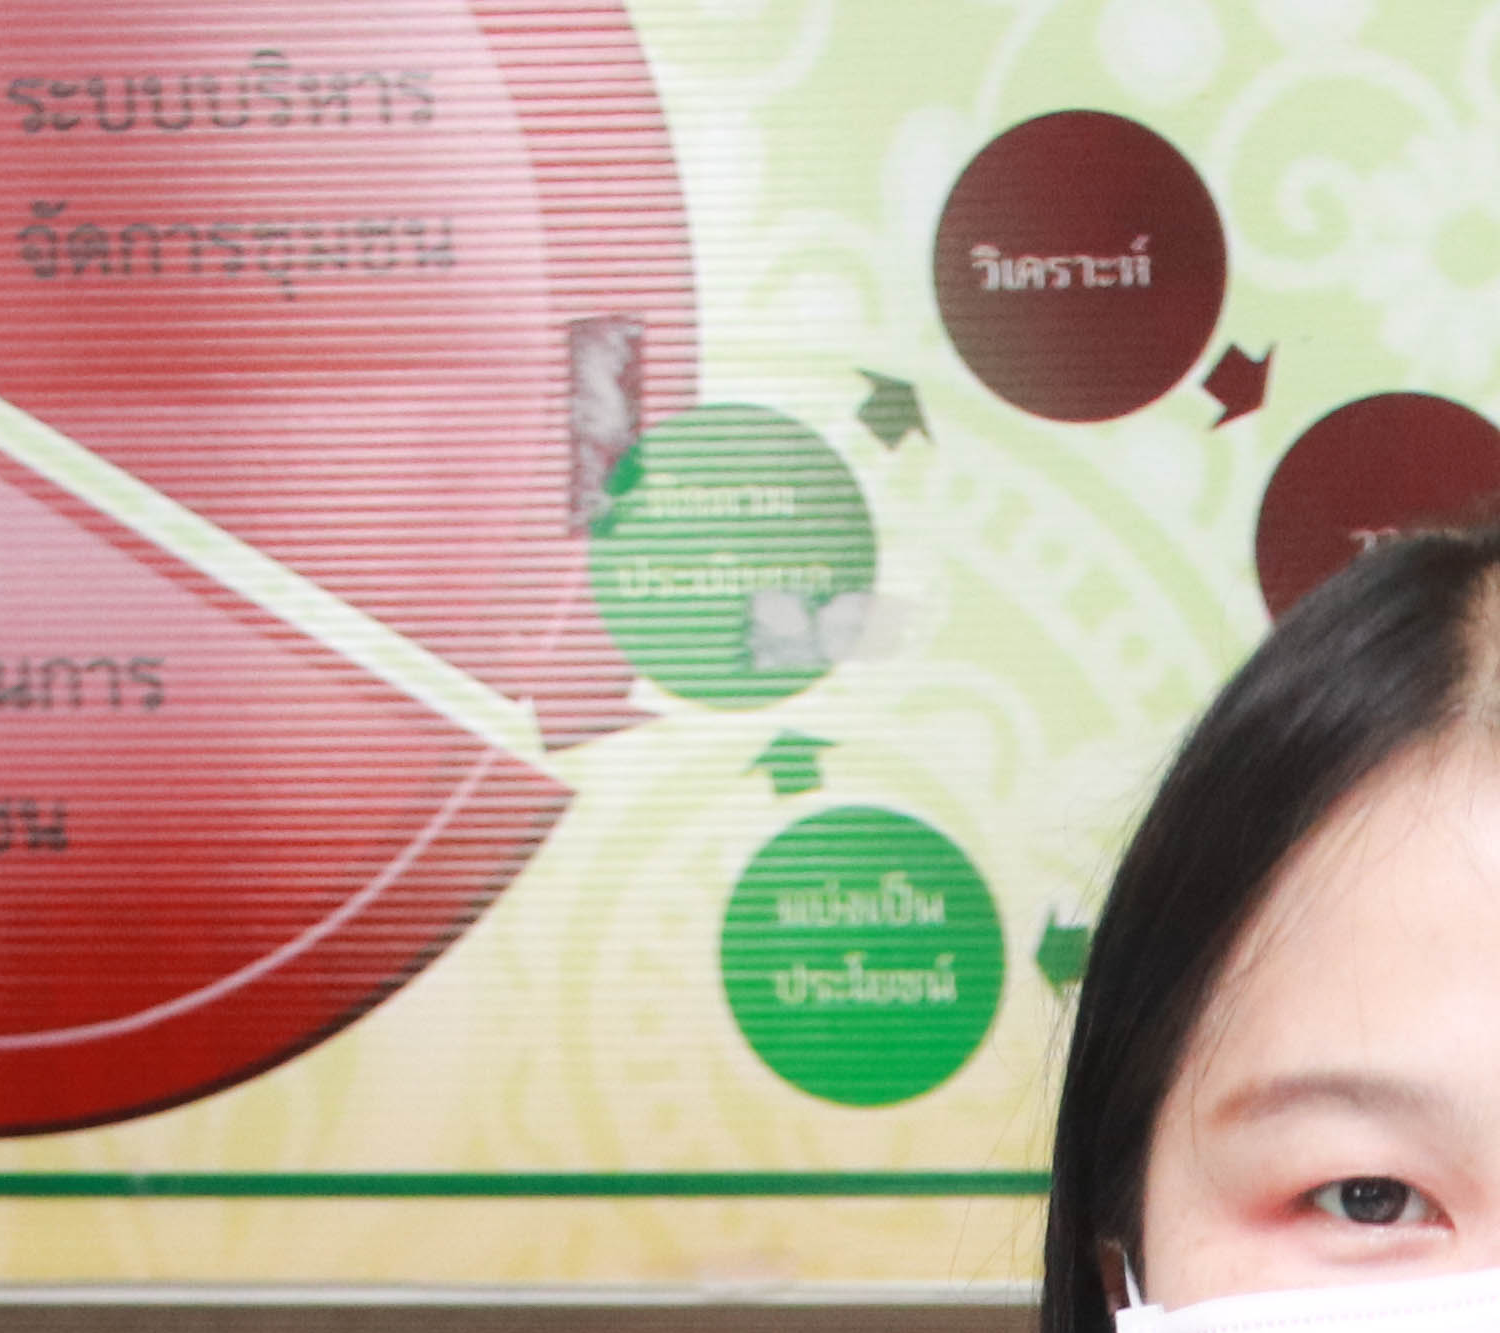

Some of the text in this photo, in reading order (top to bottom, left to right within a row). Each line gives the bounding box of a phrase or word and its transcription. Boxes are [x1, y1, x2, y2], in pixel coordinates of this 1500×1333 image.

[6, 49, 436, 134] ระบบบริหาร
[16, 200, 458, 301] จัดการชุมชน
[969, 233, 1152, 291] วิเคราะห์
